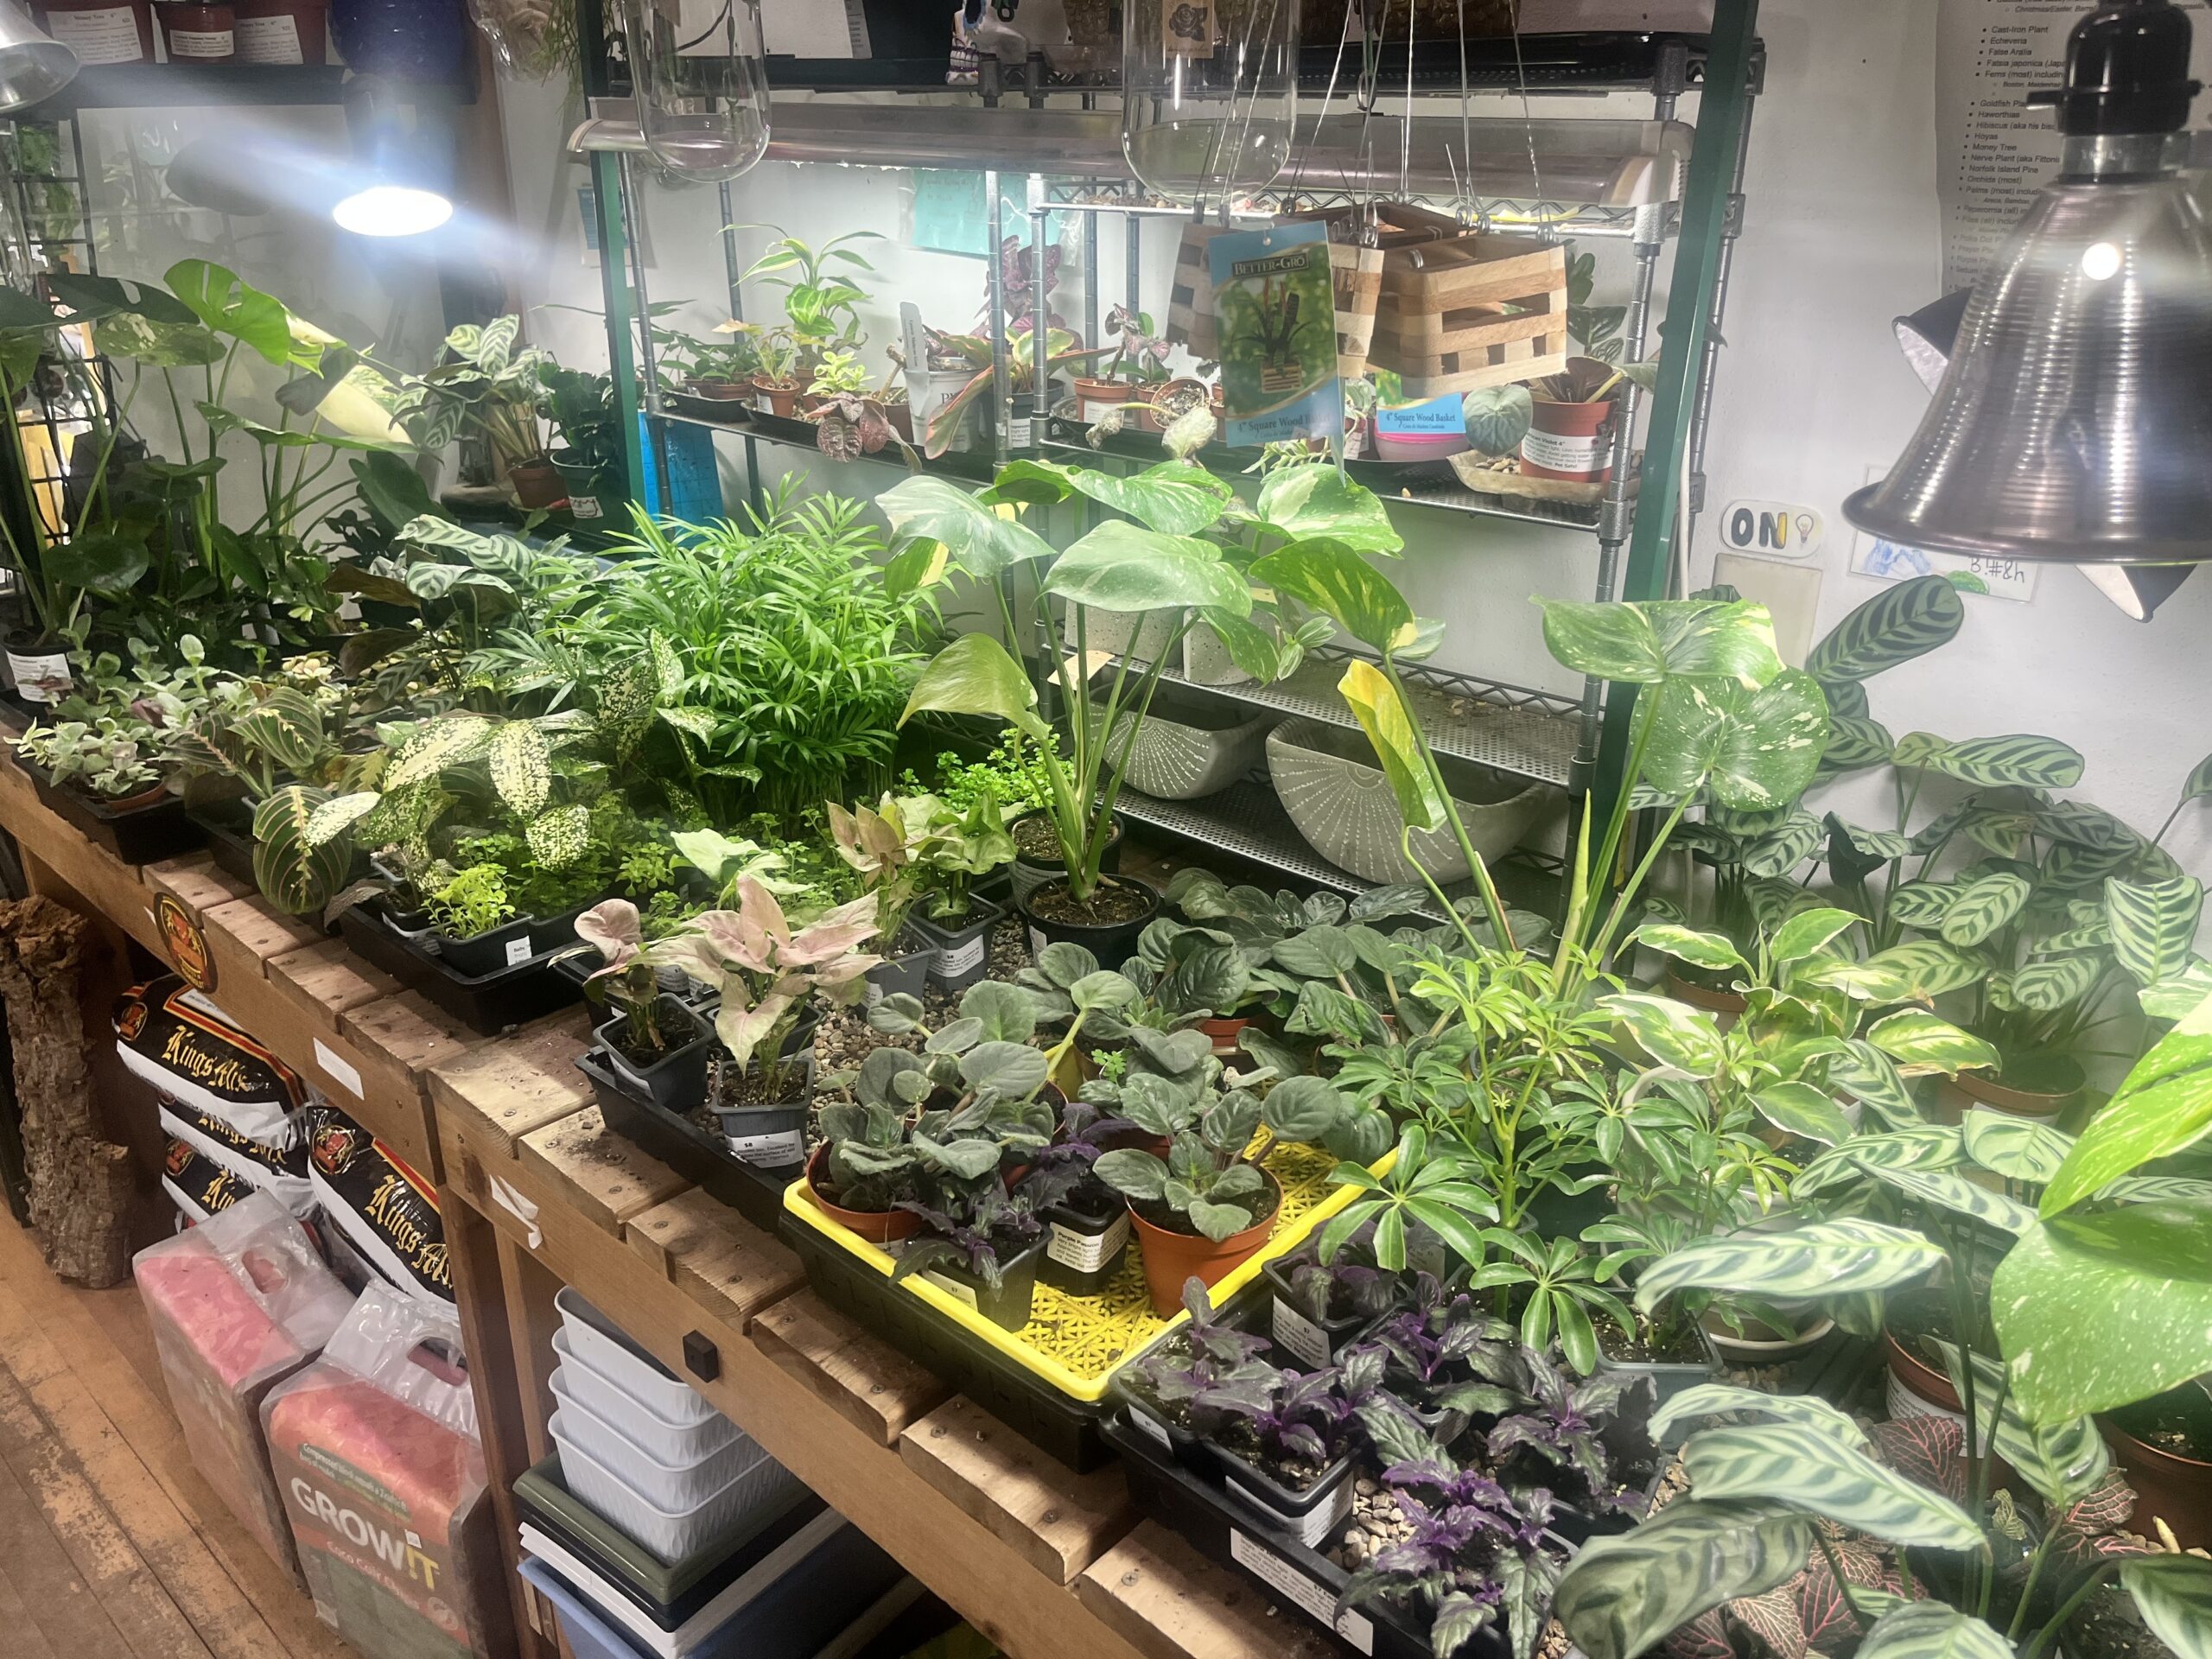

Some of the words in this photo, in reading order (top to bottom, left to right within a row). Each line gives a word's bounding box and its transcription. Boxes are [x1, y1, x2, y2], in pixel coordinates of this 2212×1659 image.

[1974, 132, 1999, 141] Hoyas
[1972, 143, 1998, 152] Money
[1249, 420, 1277, 433] Square
[1279, 415, 1303, 427] Wood
[1394, 413, 1414, 425] Square
[1416, 412, 1434, 422] Wood
[1435, 413, 1456, 422] Basket
[1541, 437, 1557, 446] Violet
[1731, 507, 1787, 550] ON
[162, 1025, 217, 1078] Kings
[200, 1167, 236, 1211] Kin
[364, 1173, 428, 1254] Kings
[1058, 1231, 1077, 1244] Purple
[1077, 1239, 1100, 1248] Passion
